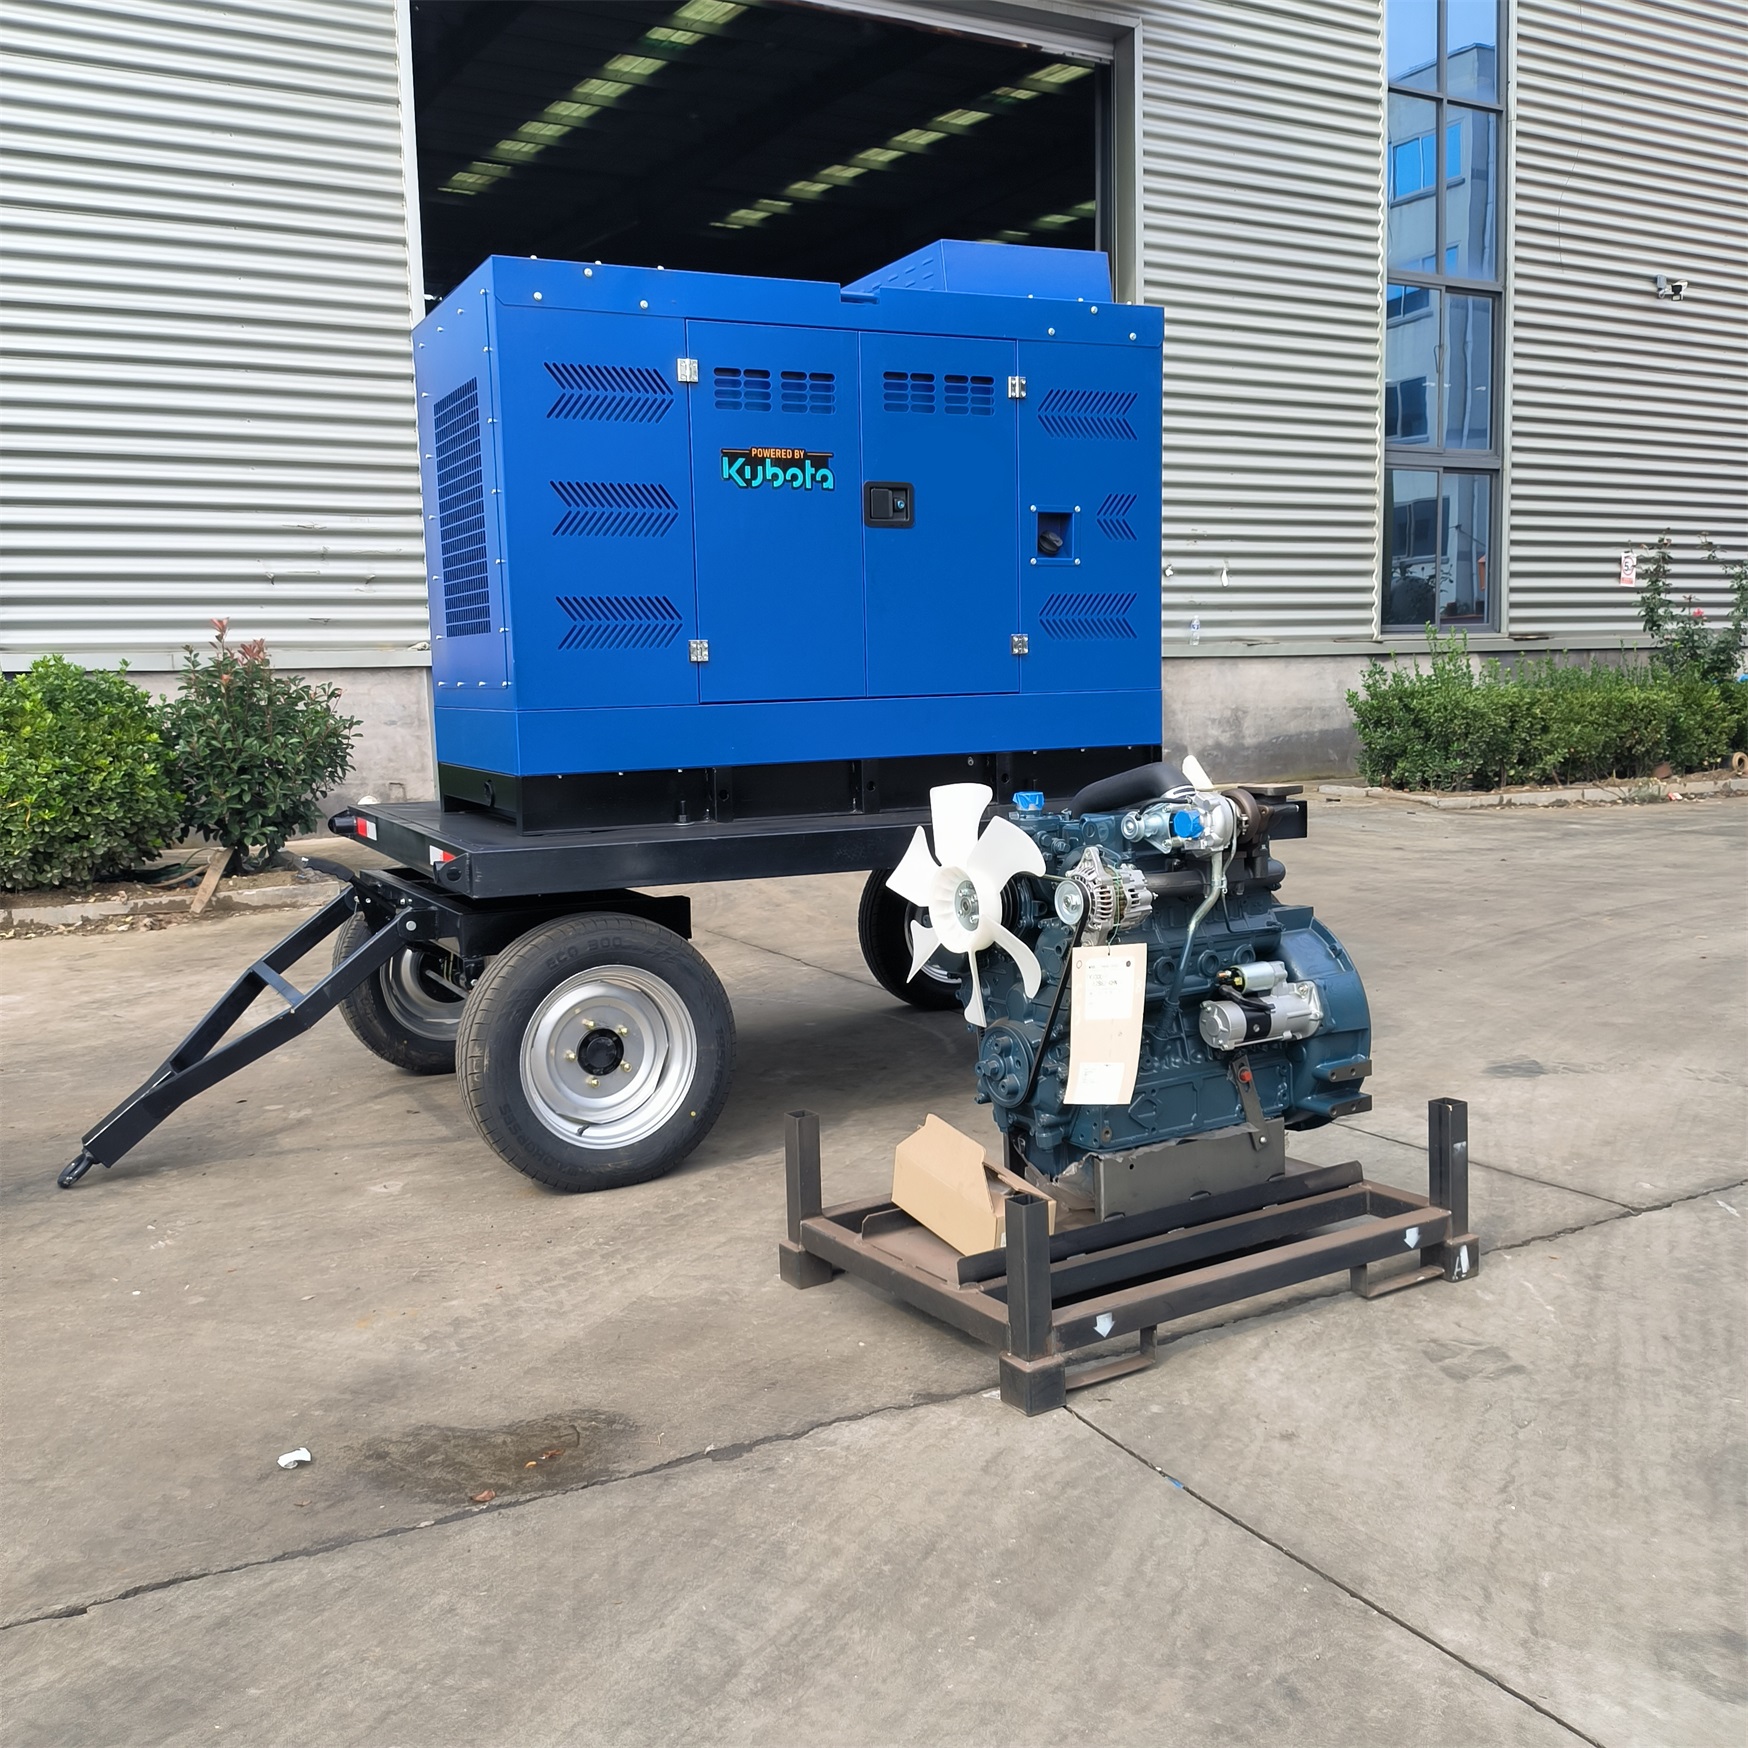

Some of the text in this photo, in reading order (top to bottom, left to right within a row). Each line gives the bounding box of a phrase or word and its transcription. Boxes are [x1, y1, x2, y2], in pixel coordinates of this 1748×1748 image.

[751, 447, 805, 459] POWERED BY
[721, 456, 834, 490] Kubota
[545, 936, 623, 971] ECO 300
